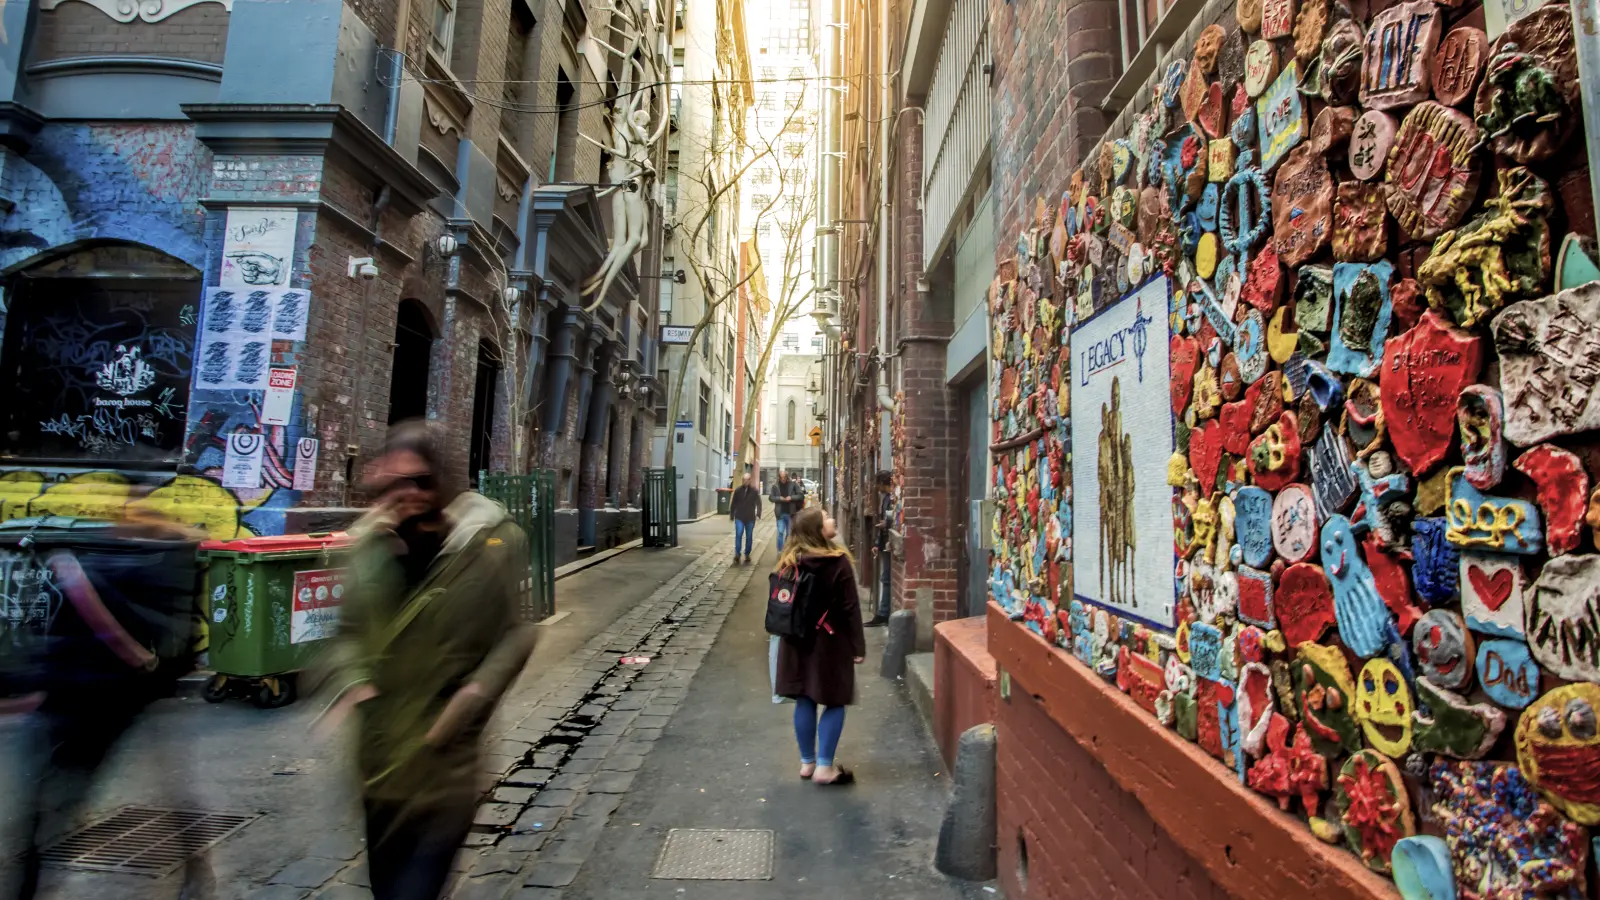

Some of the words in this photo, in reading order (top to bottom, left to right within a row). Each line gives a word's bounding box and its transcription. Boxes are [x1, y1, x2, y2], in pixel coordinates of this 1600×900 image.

[1081, 328, 1128, 387] LEGACY
[272, 371, 295, 379] LOADING
[271, 378, 293, 387] ZONE
[124, 397, 152, 406] house
